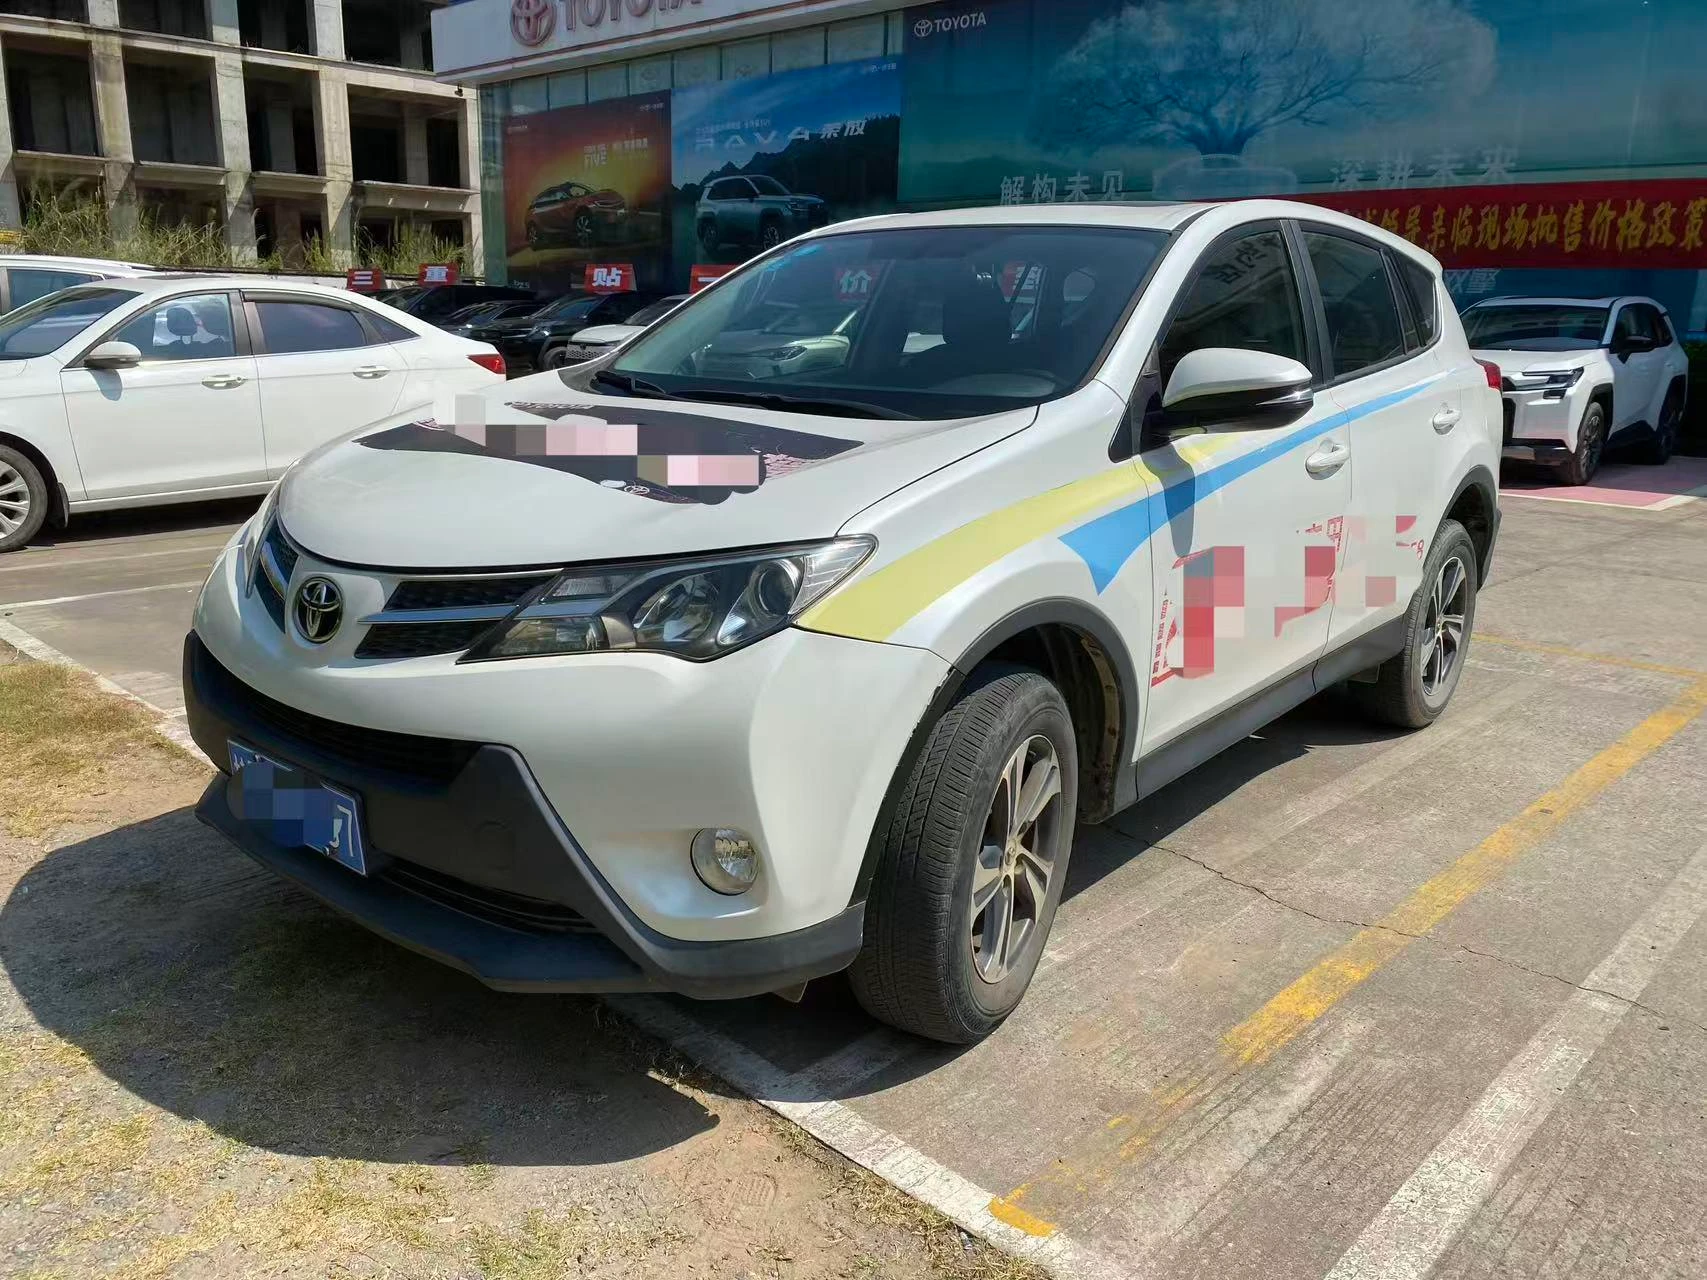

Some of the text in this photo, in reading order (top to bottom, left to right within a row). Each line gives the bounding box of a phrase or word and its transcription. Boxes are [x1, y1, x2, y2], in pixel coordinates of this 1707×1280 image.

[934, 12, 987, 33] TOYOTA
[1000, 170, 1128, 205] 解构未见
[352, 271, 374, 285] 三
[424, 266, 449, 283] 重
[592, 267, 623, 288] 贴
[839, 270, 873, 294] 价
